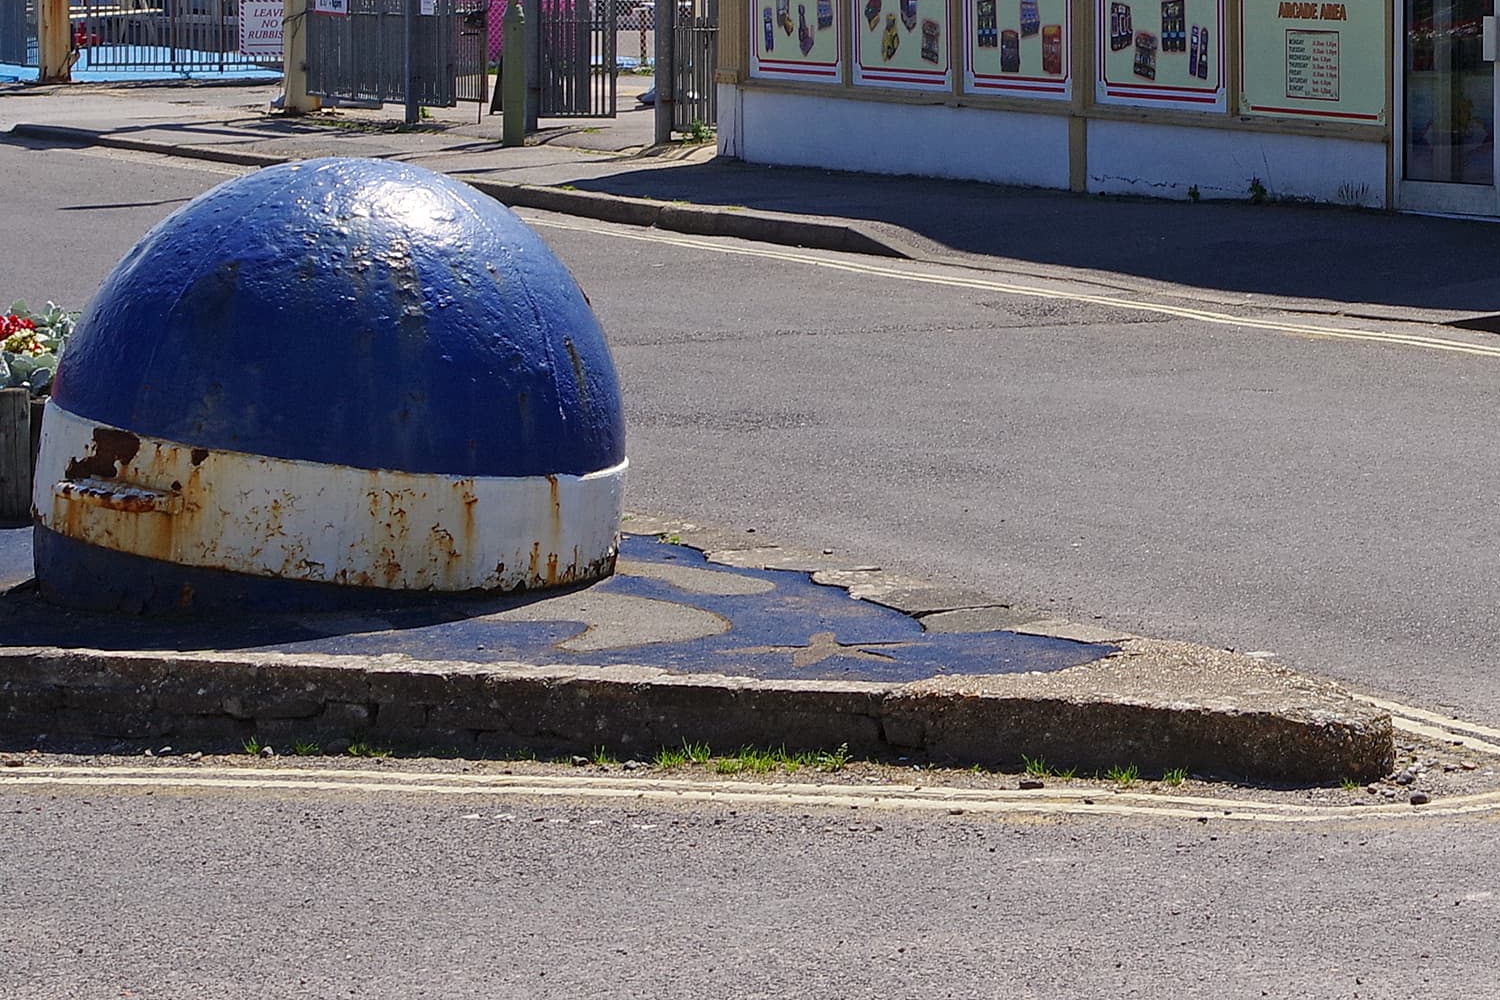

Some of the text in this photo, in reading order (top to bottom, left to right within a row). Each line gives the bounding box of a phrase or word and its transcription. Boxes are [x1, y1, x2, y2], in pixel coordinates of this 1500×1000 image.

[1278, 1, 1347, 21] ARCADE AREA
[261, 20, 278, 28] NO
